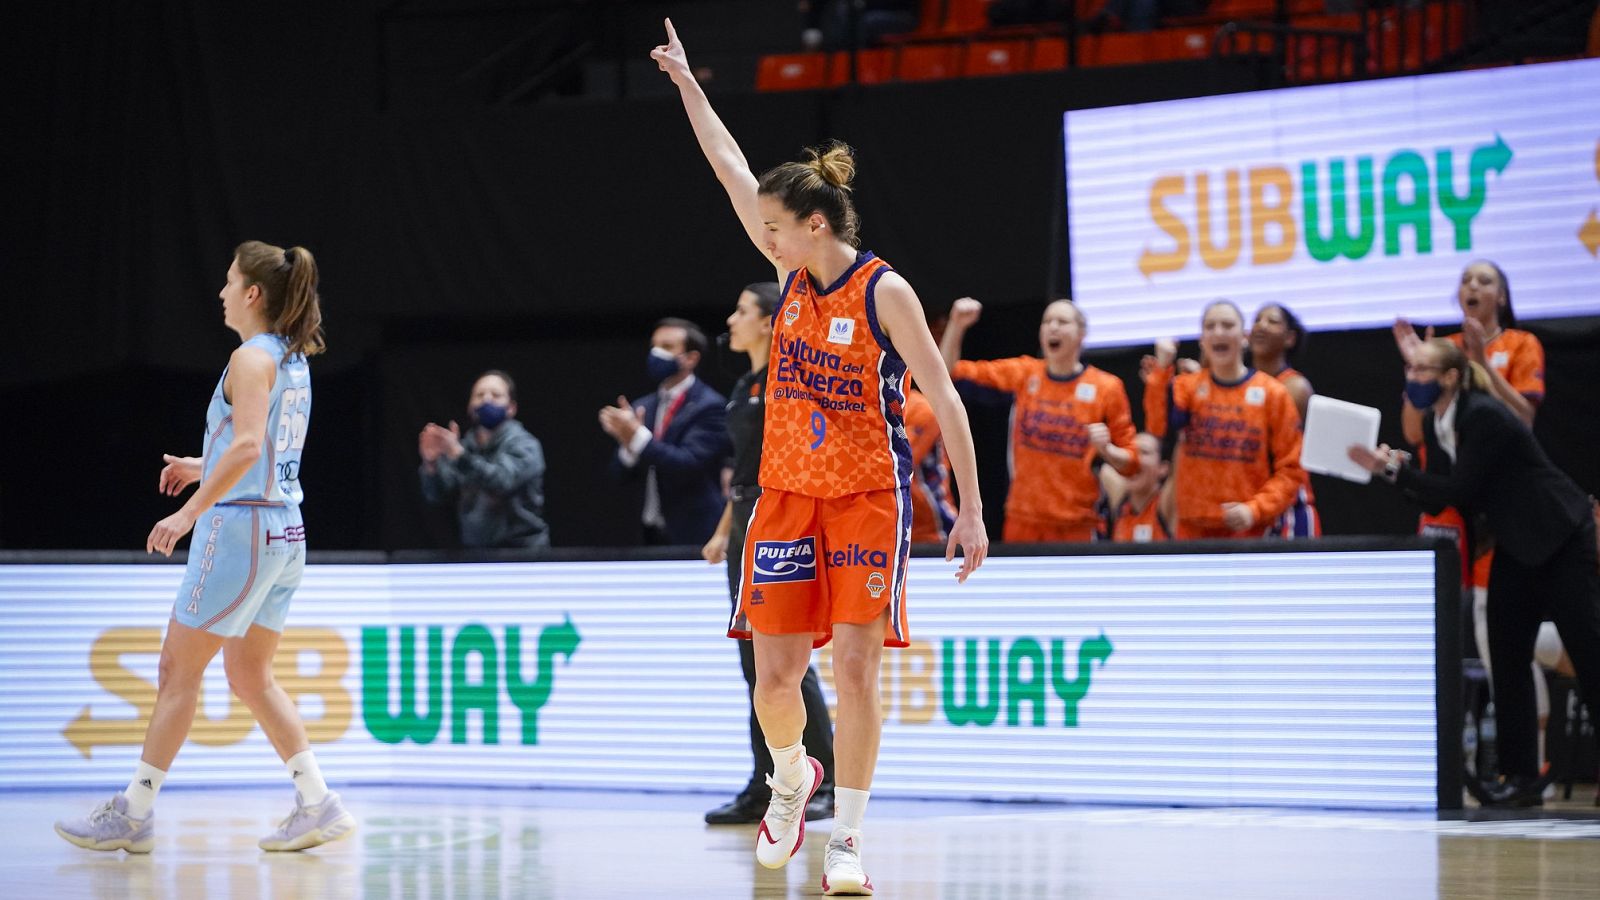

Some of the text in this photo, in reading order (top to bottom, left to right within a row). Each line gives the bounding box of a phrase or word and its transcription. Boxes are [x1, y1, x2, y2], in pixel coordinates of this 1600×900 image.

[1138, 131, 1514, 283] SUBWAY
[779, 332, 864, 374] Cultura del
[777, 357, 863, 397] Esfuerzo
[774, 386, 867, 413] @ValencaBasket
[810, 410, 826, 449] 9
[186, 515, 223, 614] GERNIKA
[757, 544, 812, 560] PULEVA
